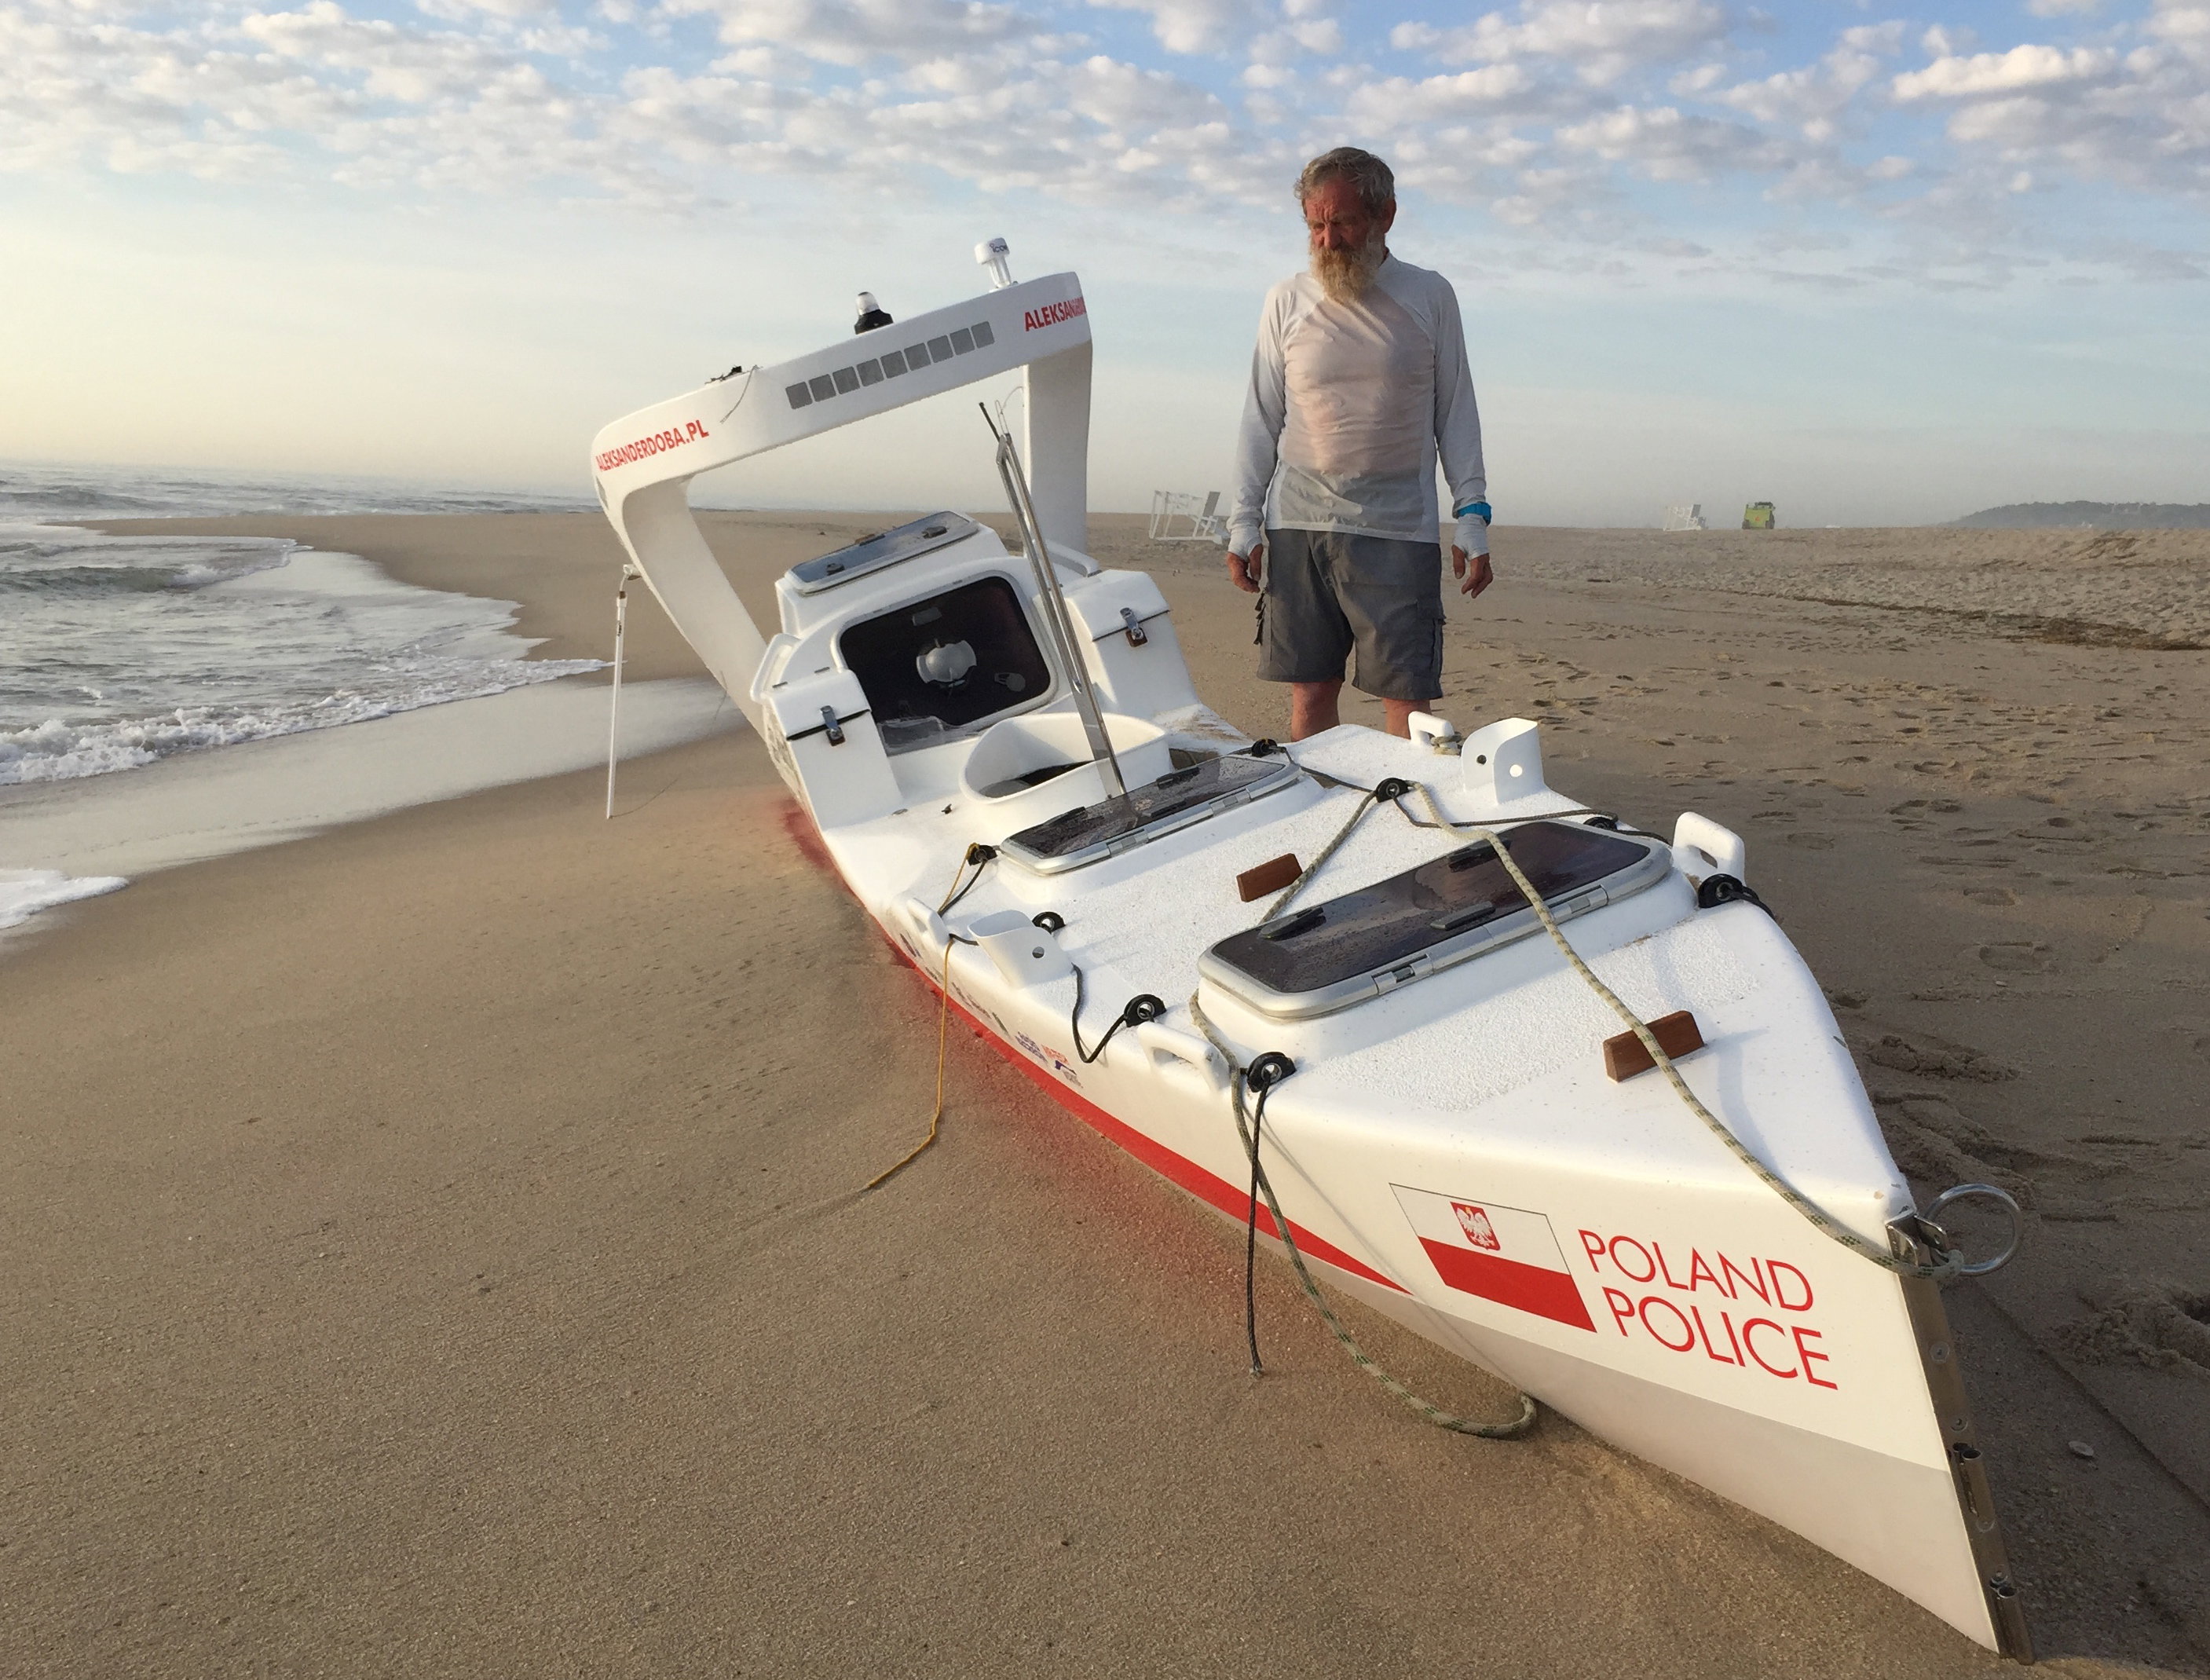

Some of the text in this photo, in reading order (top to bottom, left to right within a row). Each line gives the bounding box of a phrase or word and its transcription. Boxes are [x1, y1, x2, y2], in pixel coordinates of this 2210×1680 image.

[595, 419, 710, 472] ALEKSANDERDOBA.PL
[1577, 1228, 1814, 1313] POLAND
[1601, 1286, 1839, 1391] POLICE
